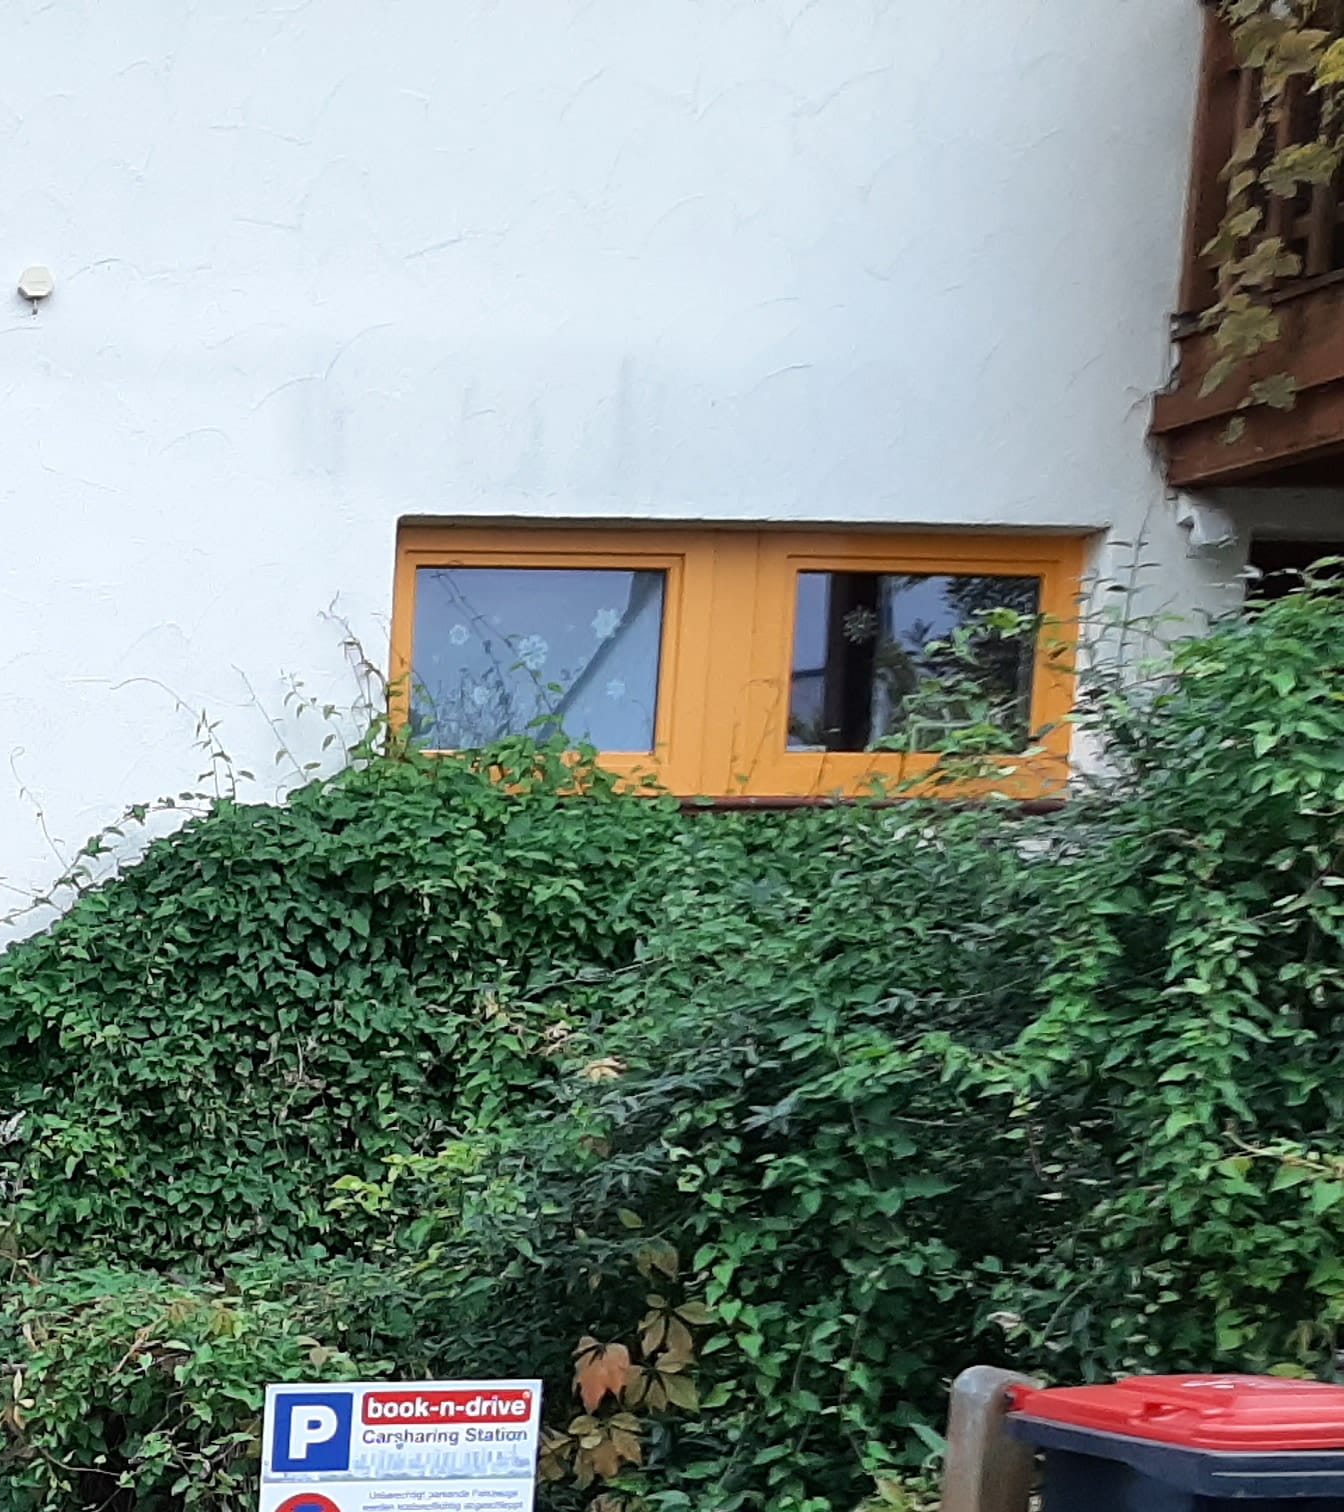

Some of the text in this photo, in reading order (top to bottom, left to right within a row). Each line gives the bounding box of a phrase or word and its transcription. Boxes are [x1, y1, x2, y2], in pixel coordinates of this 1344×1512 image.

[367, 1395, 526, 1418] book-n-drive
[288, 1405, 338, 1460] P
[362, 1427, 527, 1445] Carsharing Station
